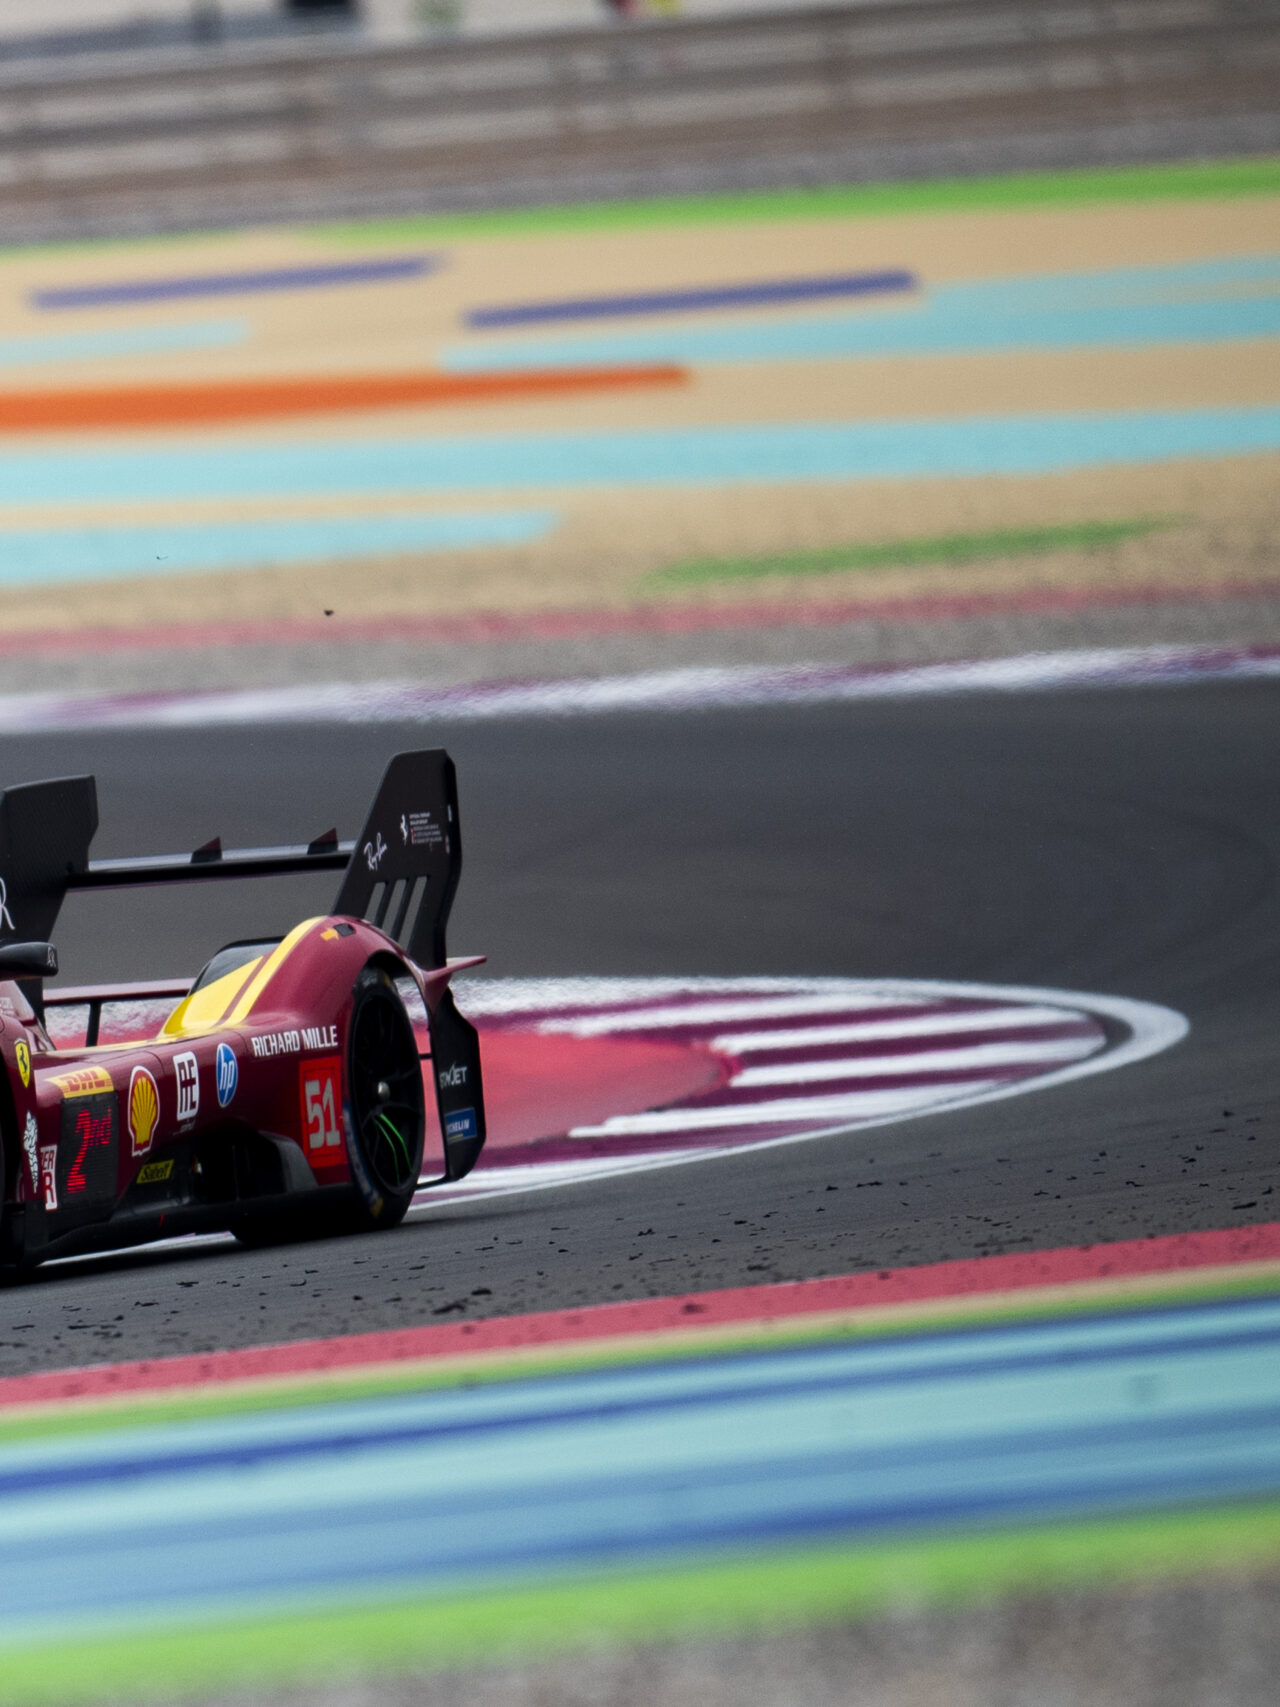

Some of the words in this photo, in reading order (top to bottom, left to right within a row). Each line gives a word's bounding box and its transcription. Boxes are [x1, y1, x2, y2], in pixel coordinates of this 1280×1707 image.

[251, 1030, 300, 1057] RICHARD
[301, 1025, 338, 1050] MILLE
[60, 1070, 107, 1092] DHL
[220, 1056, 235, 1107] hp
[305, 1077, 341, 1149] 51
